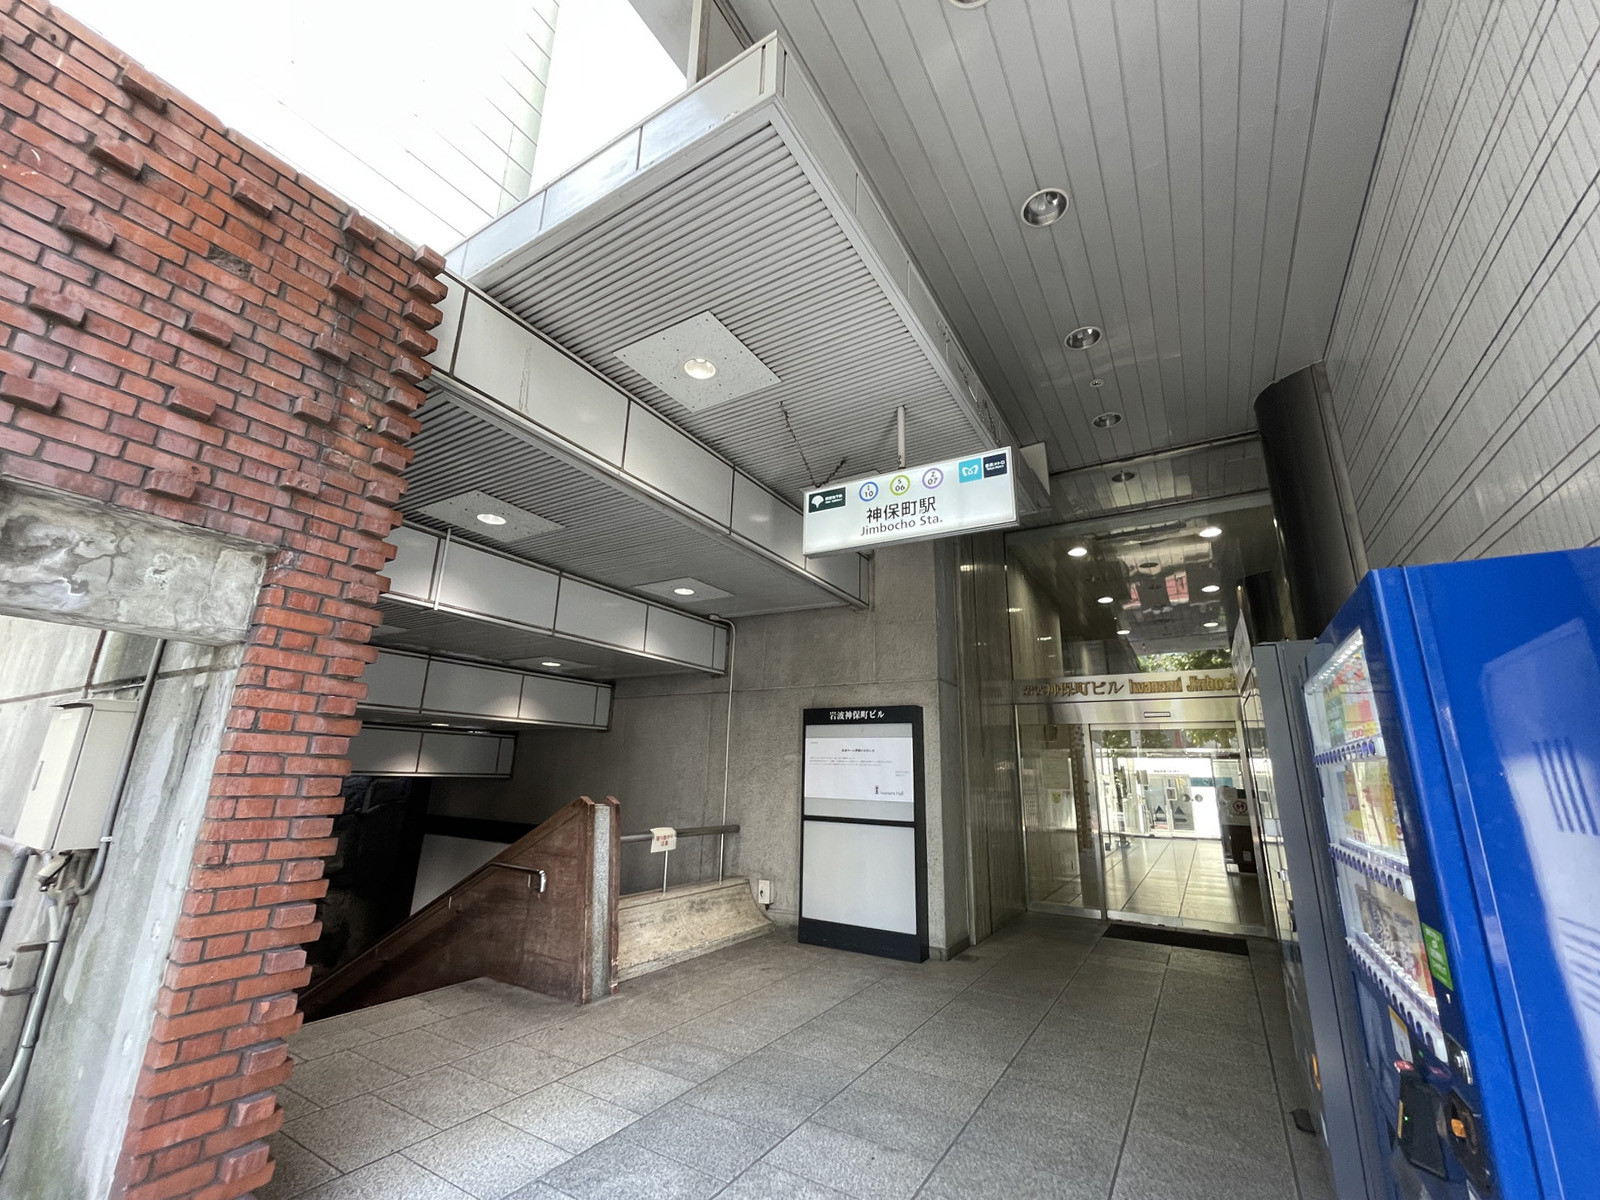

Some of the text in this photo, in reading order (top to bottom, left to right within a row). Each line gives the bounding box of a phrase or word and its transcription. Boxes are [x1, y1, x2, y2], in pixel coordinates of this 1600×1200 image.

[927, 477, 939, 485] 07
[864, 490, 874, 498] 10
[866, 496, 937, 524] 神保町駅
[860, 514, 944, 536] Jimbocho Sta.
[829, 709, 885, 721] 岩波神保町ビル
